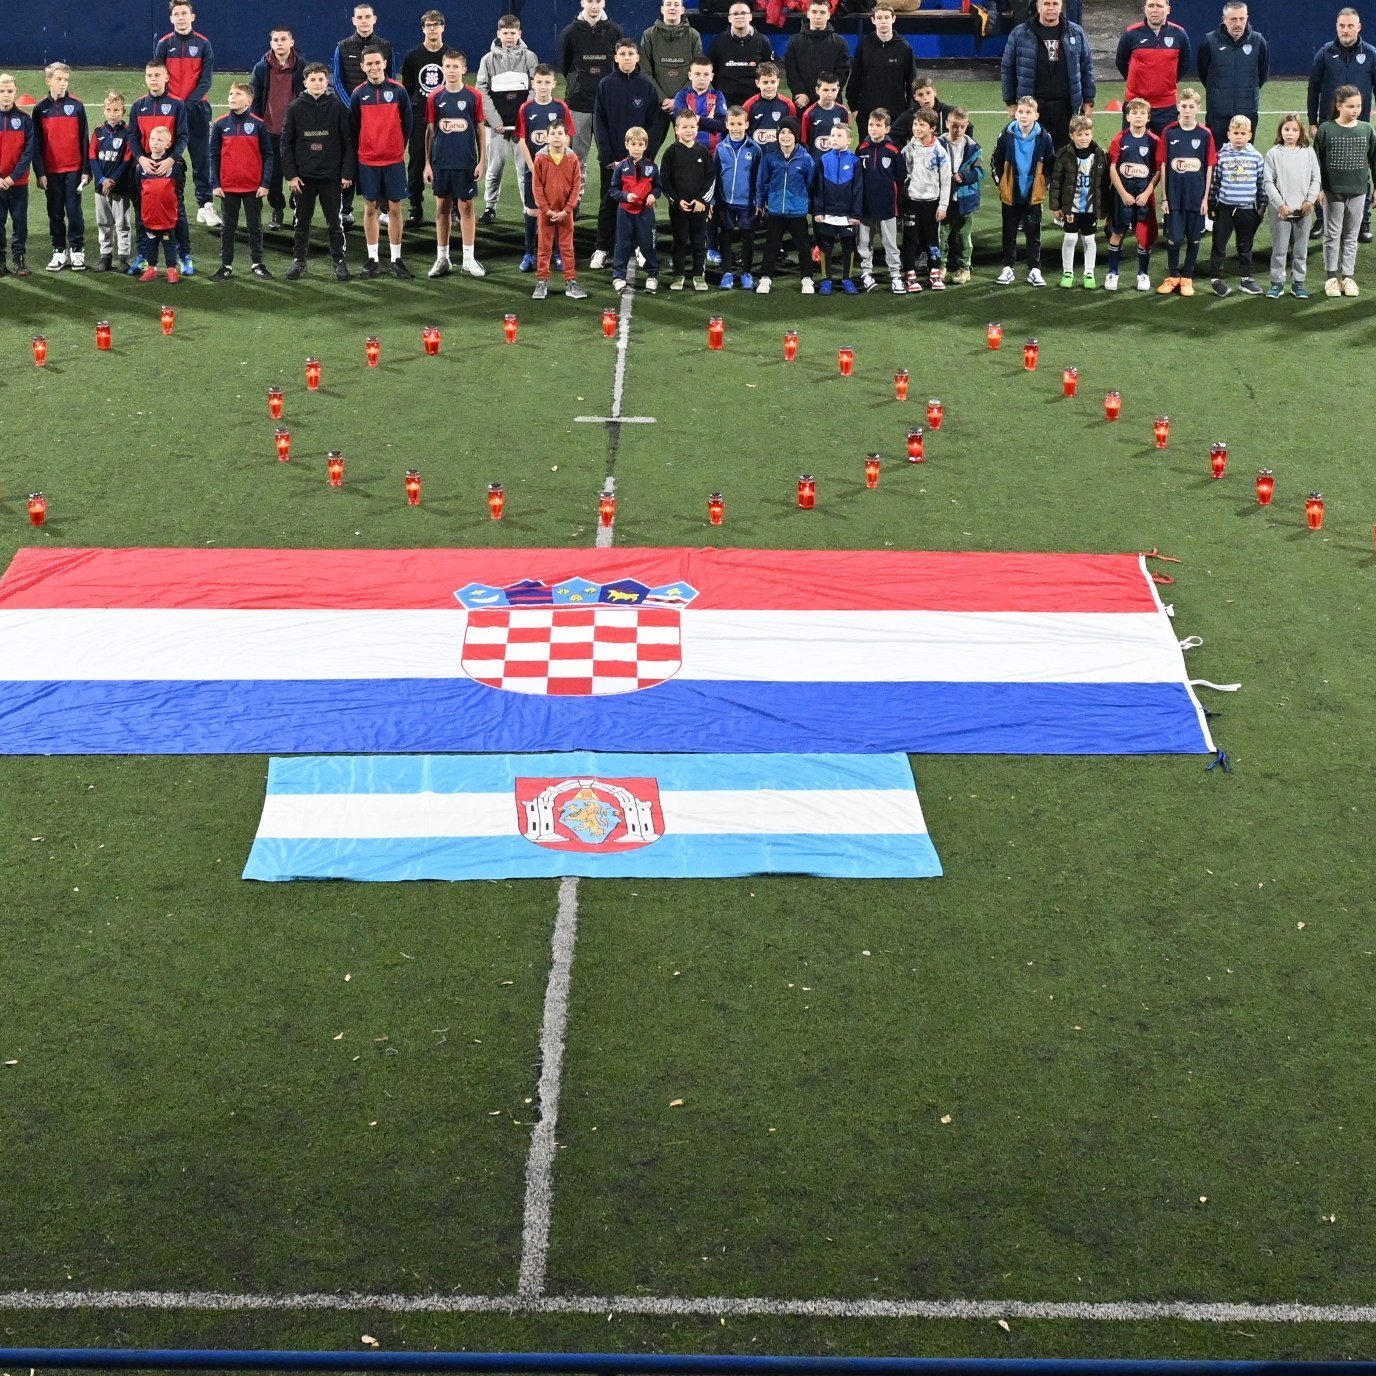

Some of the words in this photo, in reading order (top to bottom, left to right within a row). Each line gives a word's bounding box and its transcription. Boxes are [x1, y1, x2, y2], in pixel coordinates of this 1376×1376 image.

[442, 121, 465, 132] Tarsa
[1125, 164, 1146, 176] Tarsa
[1176, 159, 1199, 171] Tarsa
